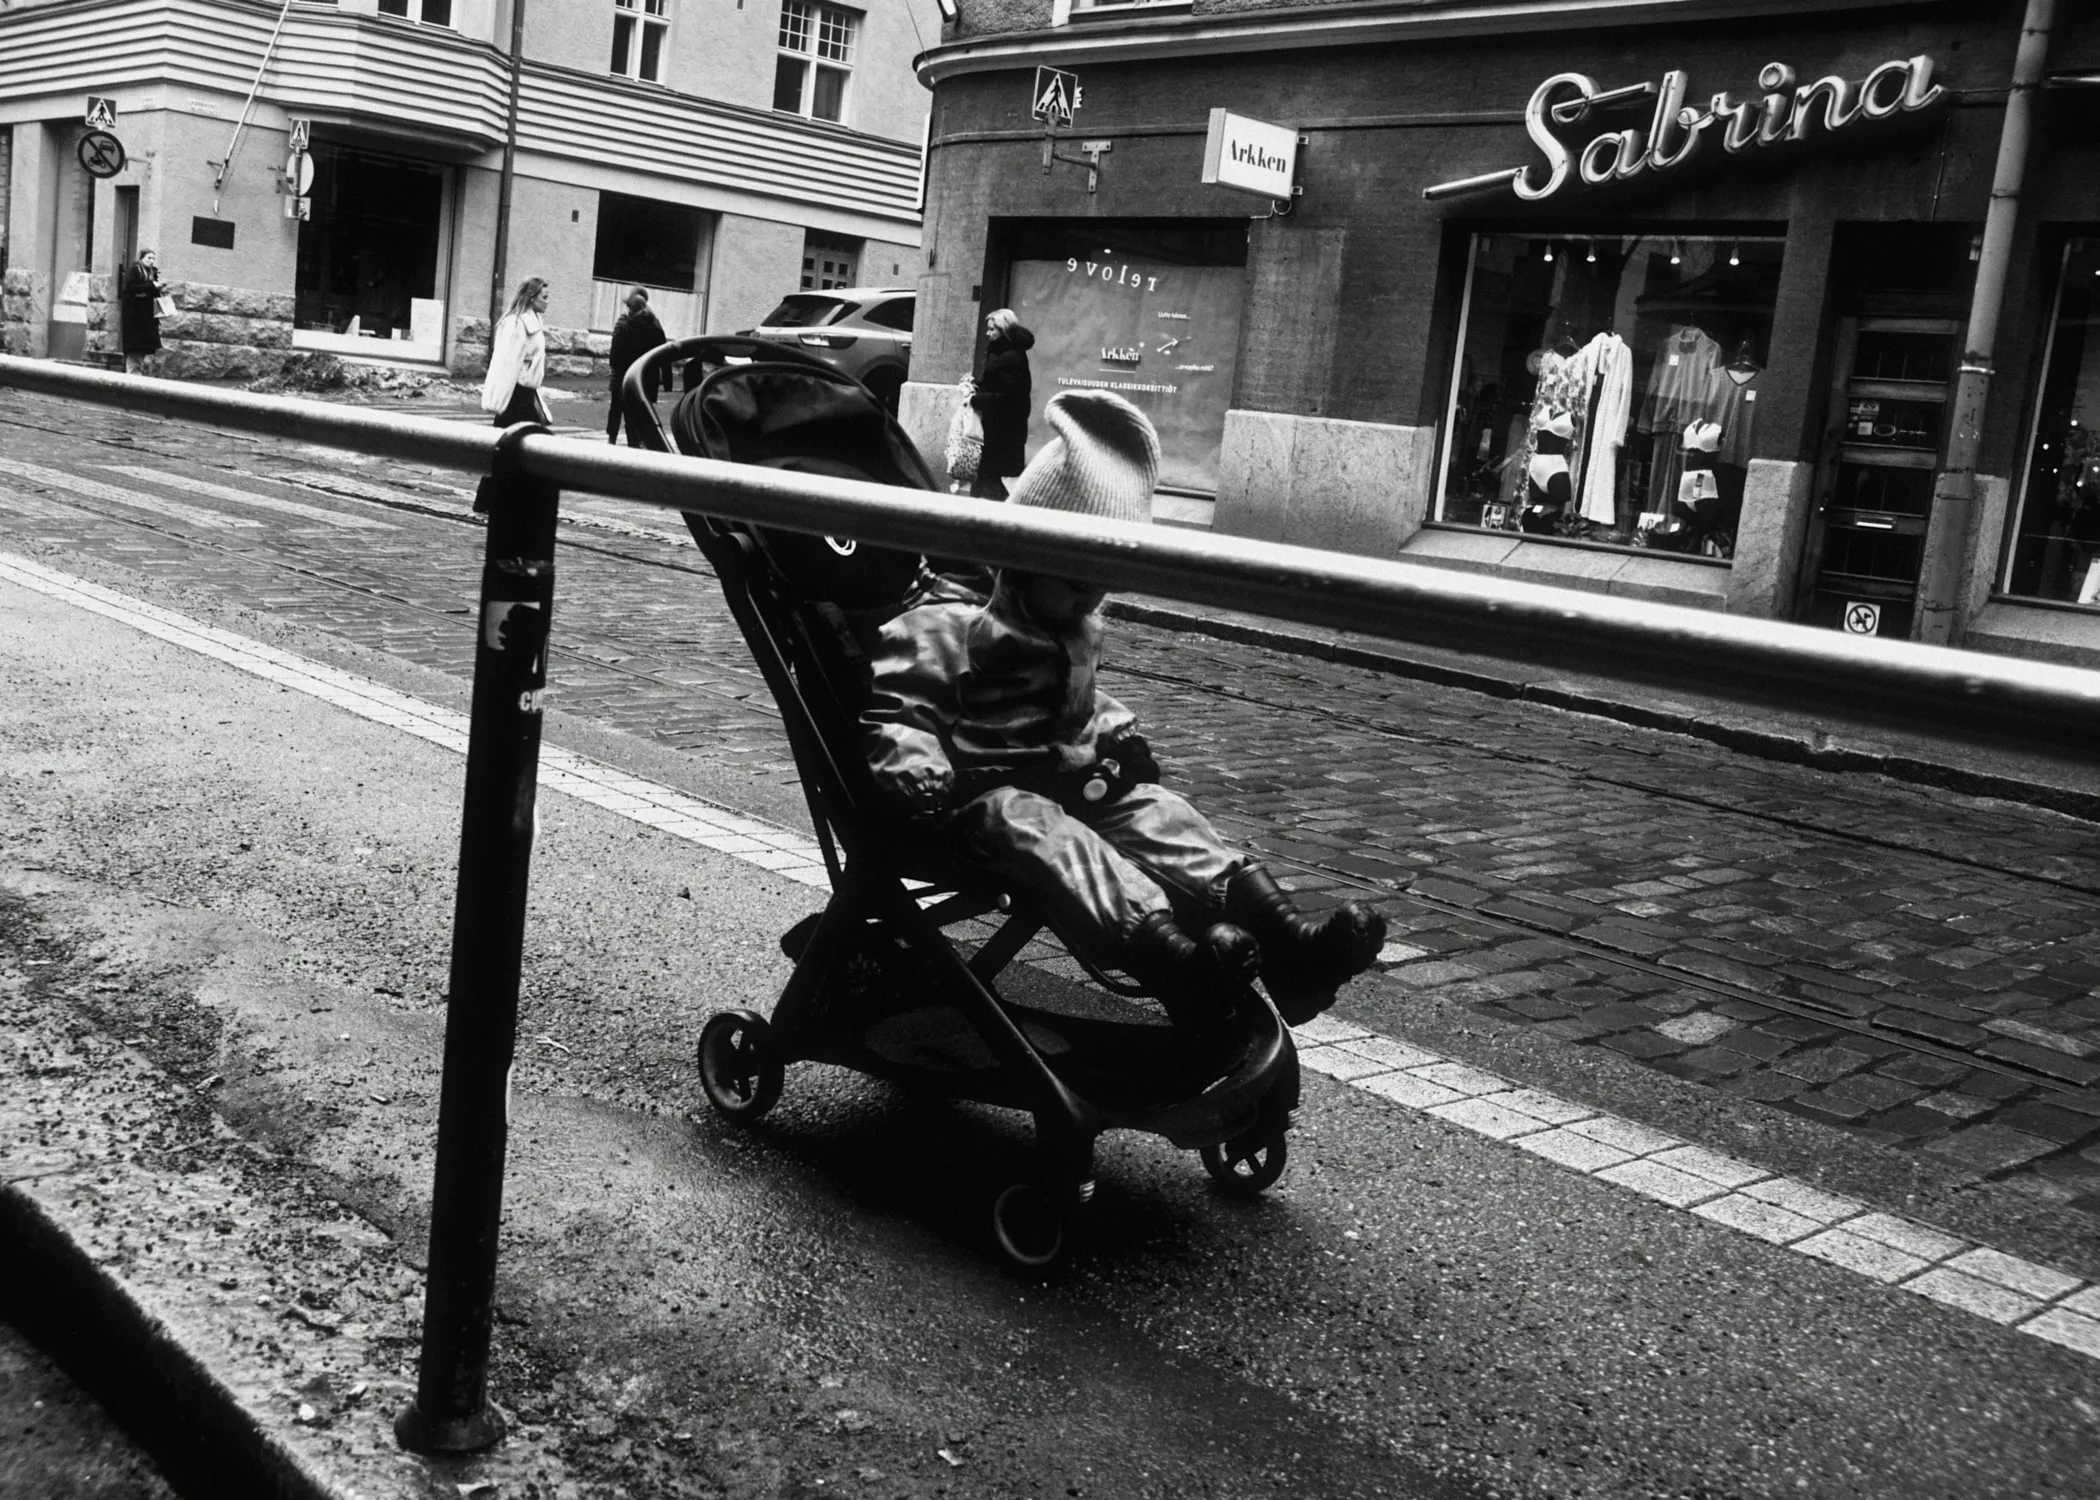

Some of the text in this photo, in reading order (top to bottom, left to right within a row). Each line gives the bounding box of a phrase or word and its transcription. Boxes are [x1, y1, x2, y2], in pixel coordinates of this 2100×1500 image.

[1423, 54, 1948, 200] Sabrina
[1227, 139, 1287, 173] Arkken
[1100, 347, 1140, 361] Arkken
[1057, 377, 1178, 394] TULEVAISUUDEN KLASSIKKOKEITTIÖT
